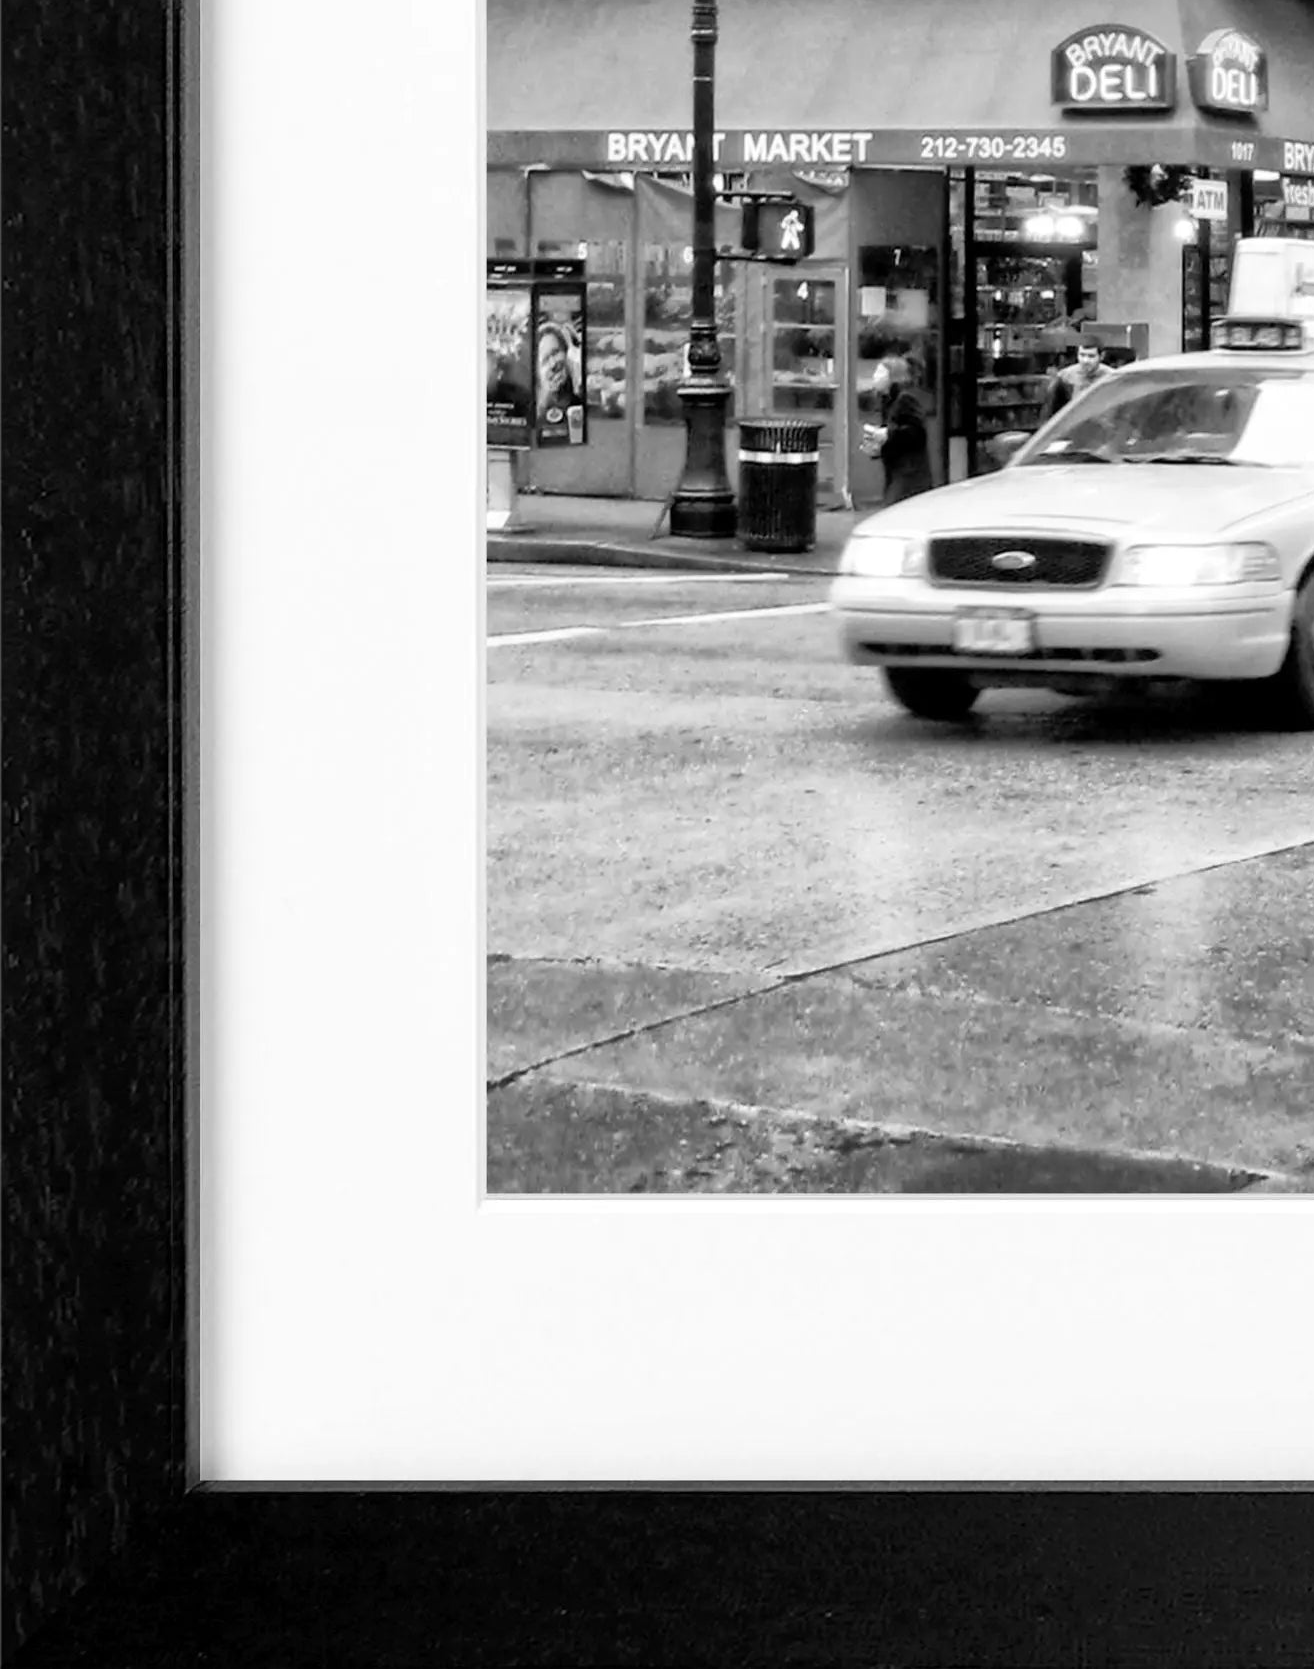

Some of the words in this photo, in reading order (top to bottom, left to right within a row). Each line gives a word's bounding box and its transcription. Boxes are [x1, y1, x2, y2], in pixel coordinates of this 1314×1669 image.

[1065, 32, 1165, 68] BRYANT
[1069, 64, 1158, 101] DELI
[1212, 67, 1257, 105] DELI
[743, 132, 873, 162] MARKET
[920, 135, 1067, 159] 212-730-2345
[1196, 190, 1226, 212] ATM
[797, 282, 809, 300] 4
